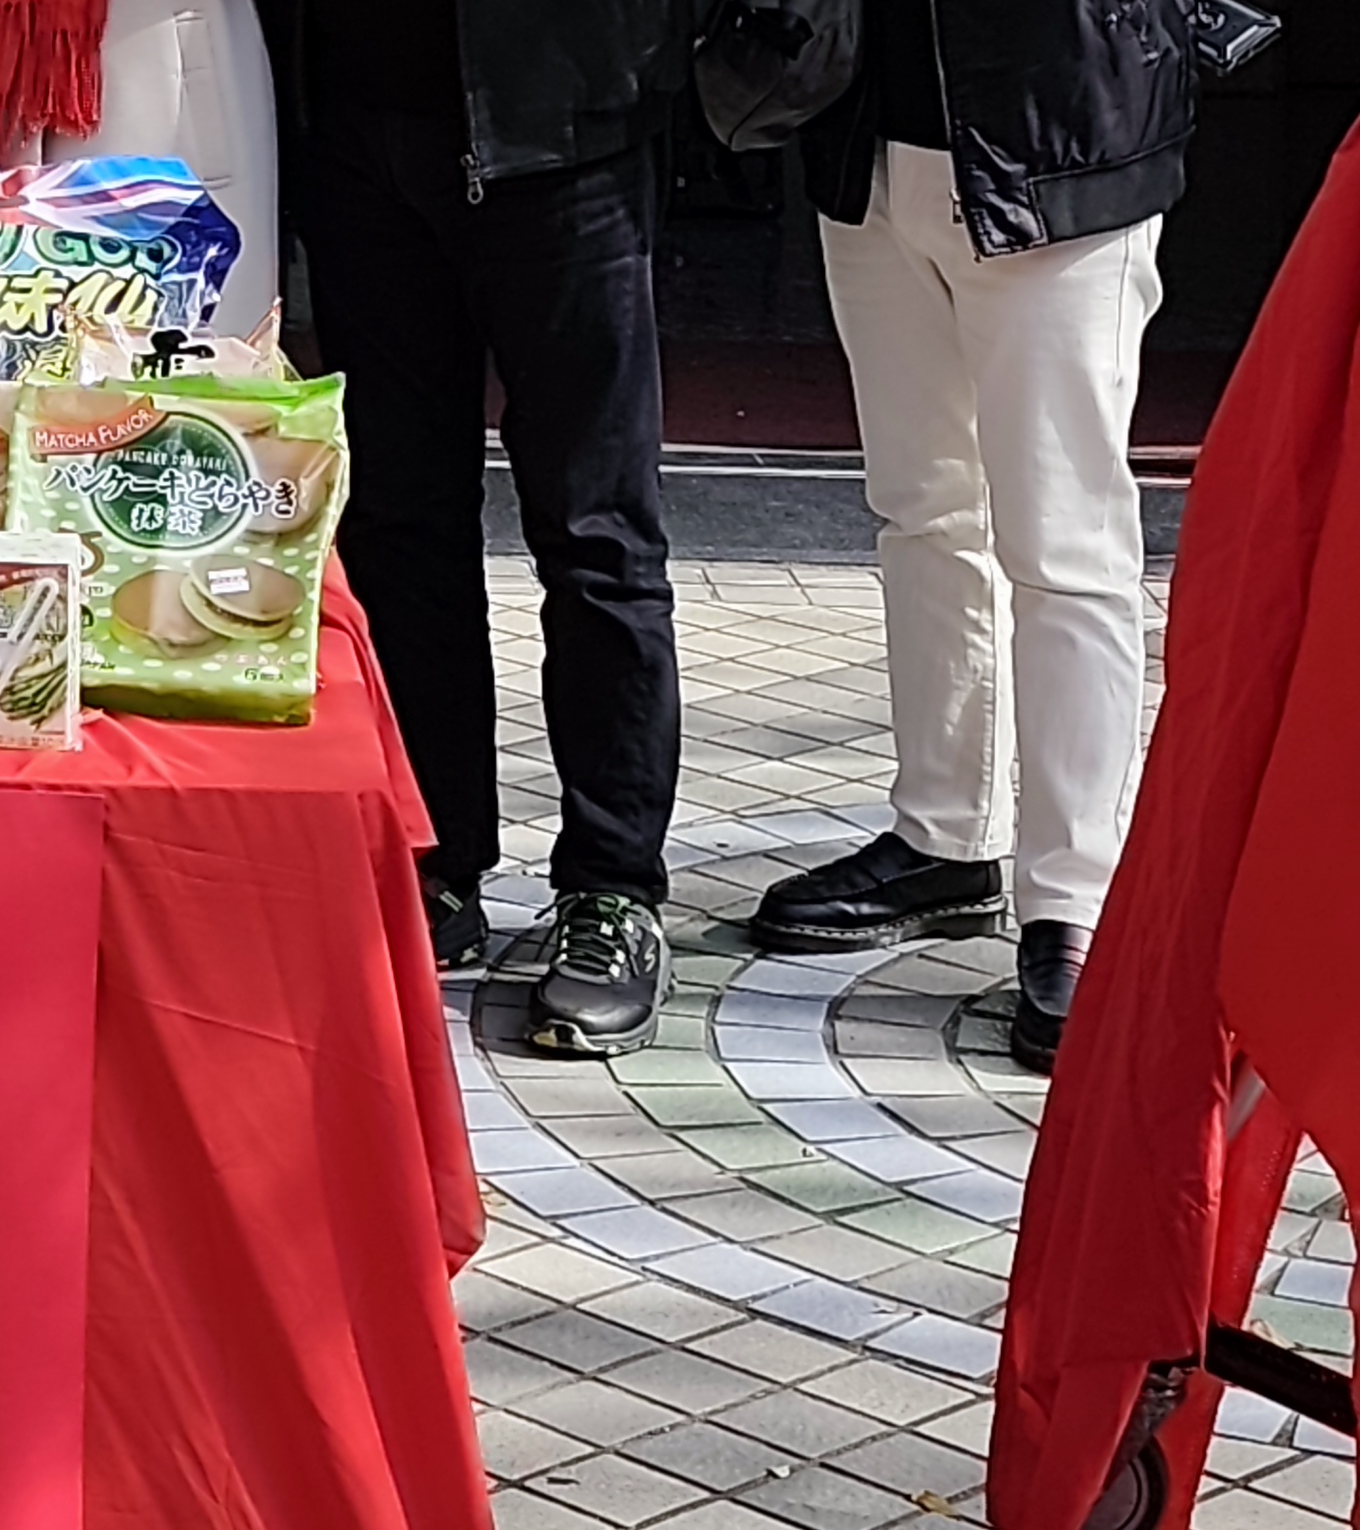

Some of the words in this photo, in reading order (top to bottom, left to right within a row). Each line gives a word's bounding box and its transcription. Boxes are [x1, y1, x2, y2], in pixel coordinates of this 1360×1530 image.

[36, 226, 179, 278] GOD
[34, 427, 96, 449] MATCHA
[97, 407, 154, 445] FLAVOR
[131, 504, 203, 534] 抹茶
